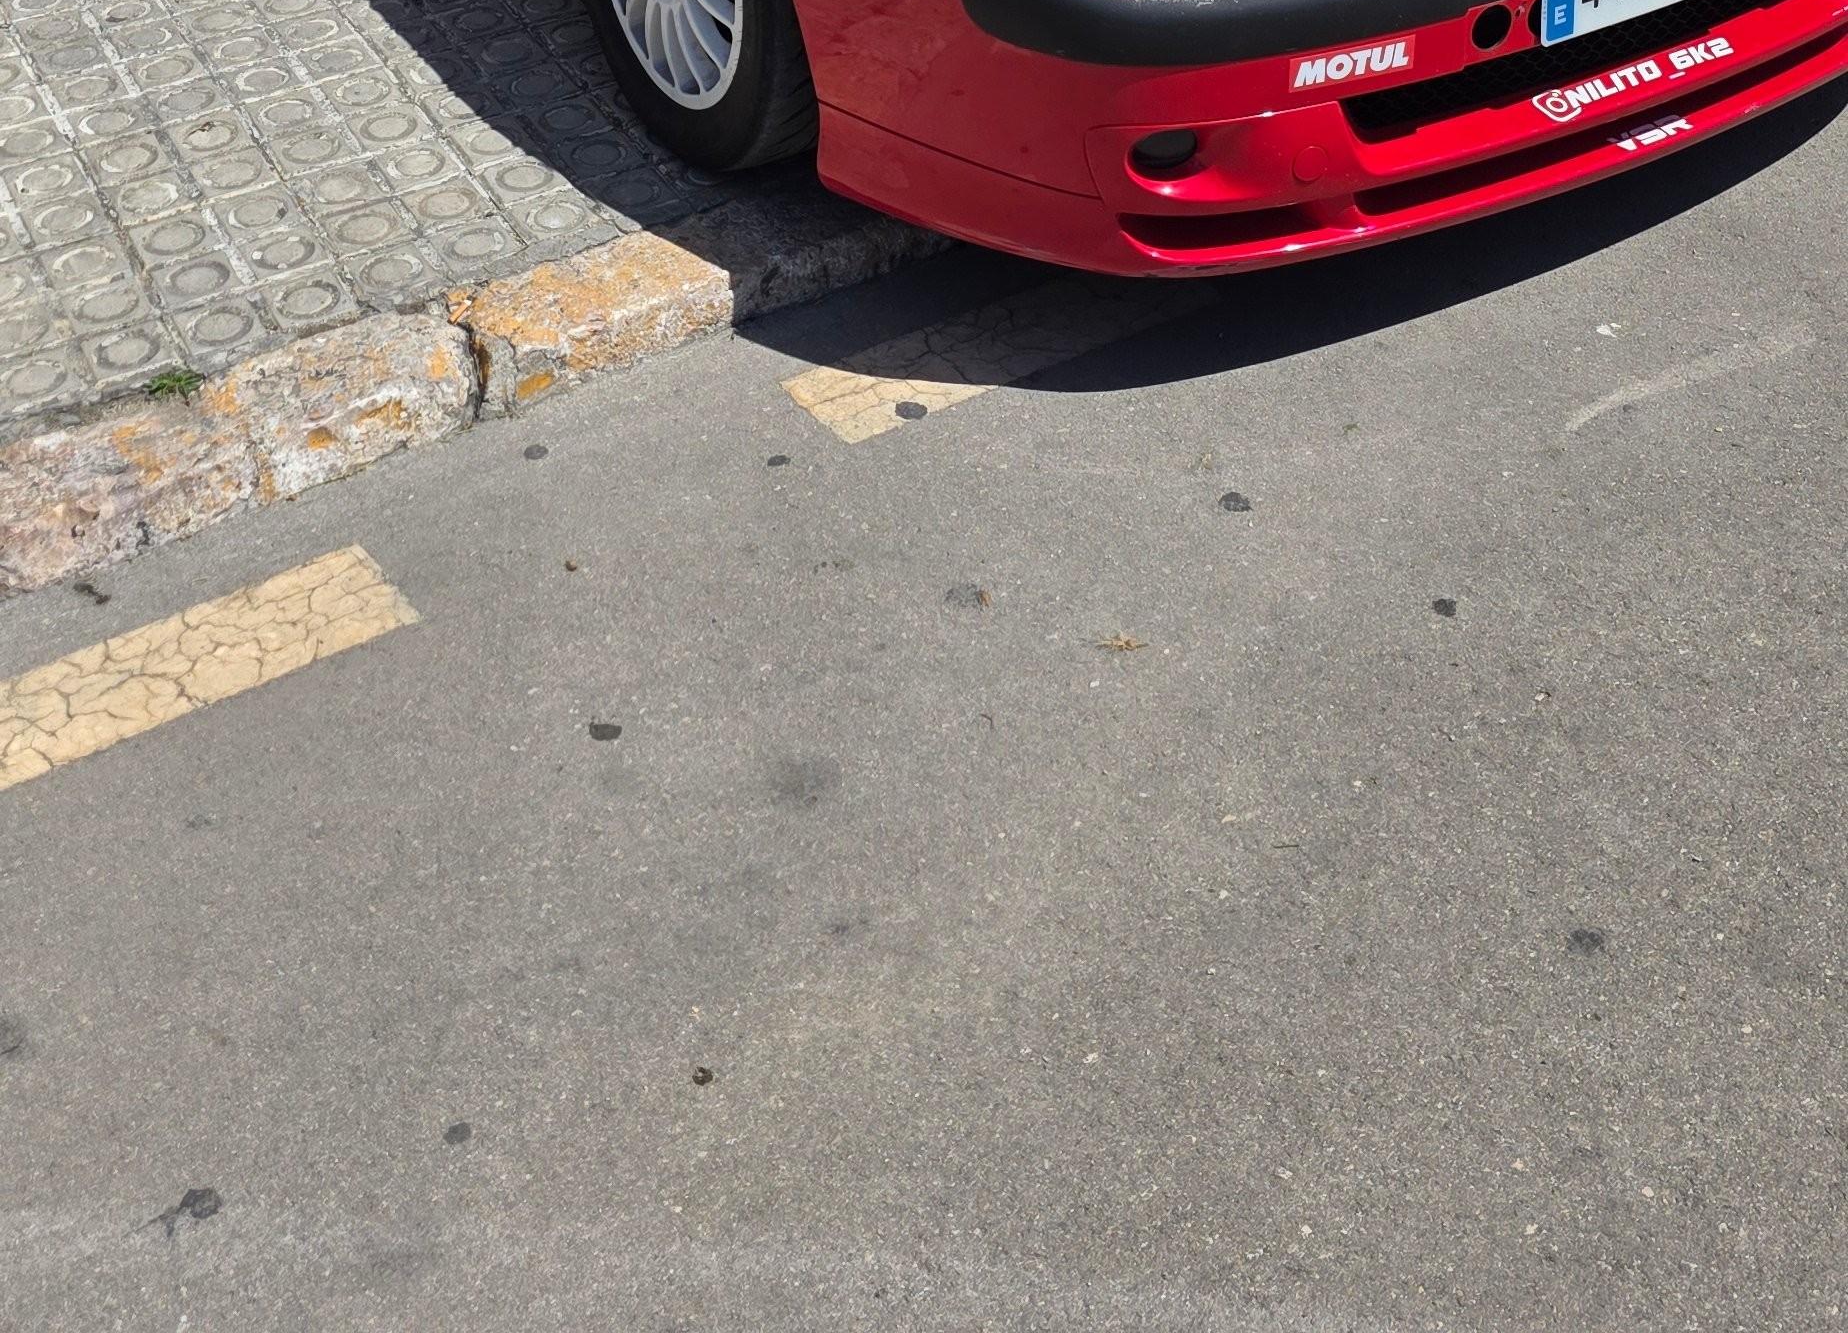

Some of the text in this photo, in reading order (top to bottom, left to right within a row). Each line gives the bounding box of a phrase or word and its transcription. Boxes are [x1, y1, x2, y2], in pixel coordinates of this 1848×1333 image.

[1554, 4, 1567, 26] E
[1294, 41, 1410, 89] MOTUL
[1606, 114, 1694, 151] VSR
